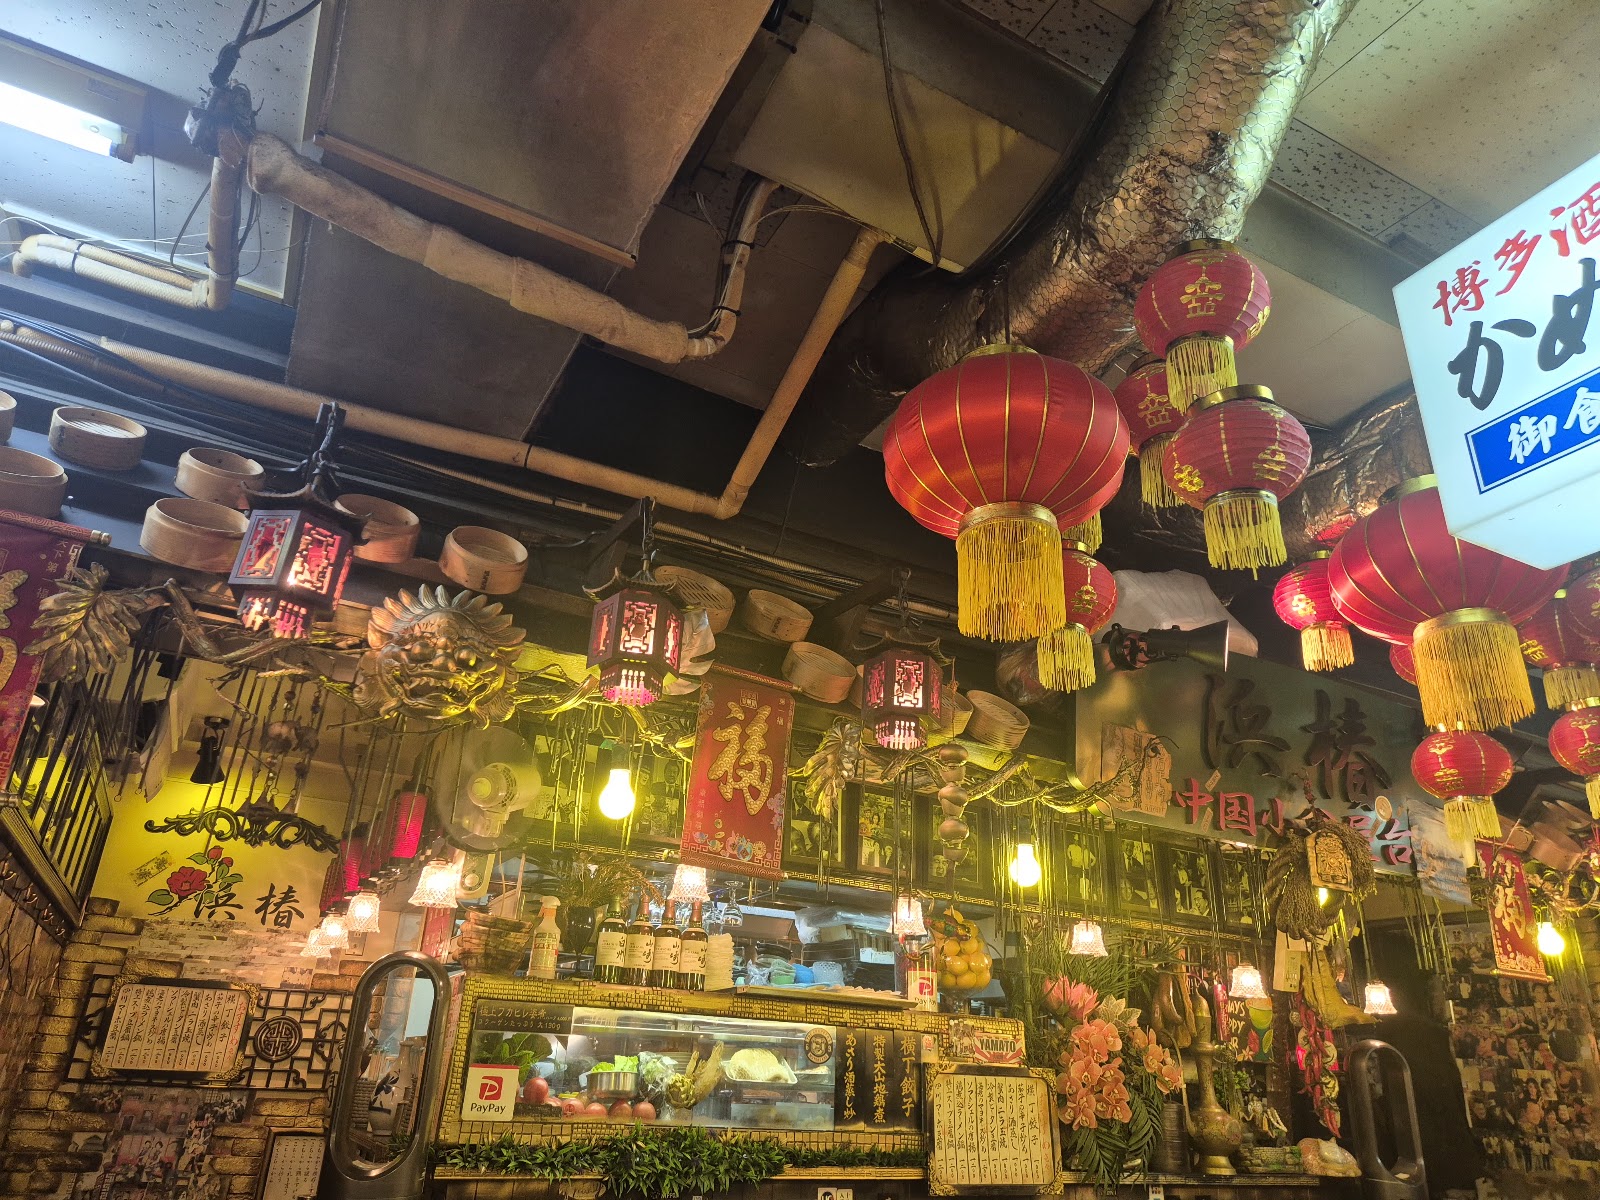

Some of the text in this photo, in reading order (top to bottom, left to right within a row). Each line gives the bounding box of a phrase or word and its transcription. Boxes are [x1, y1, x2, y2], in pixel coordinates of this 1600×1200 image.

[1433, 182, 1600, 326] 博多酒
[1447, 257, 1600, 411] かめ
[1508, 386, 1600, 465] 御食
[1172, 777, 1413, 866] 中国小台
[193, 883, 305, 928] 浜椿
[873, 1035, 887, 1124] 特製大山地鶏煮
[899, 1036, 917, 1118] 横丁餃子
[979, 1038, 1016, 1053] YAMATO
[470, 1102, 506, 1114] PayPay
